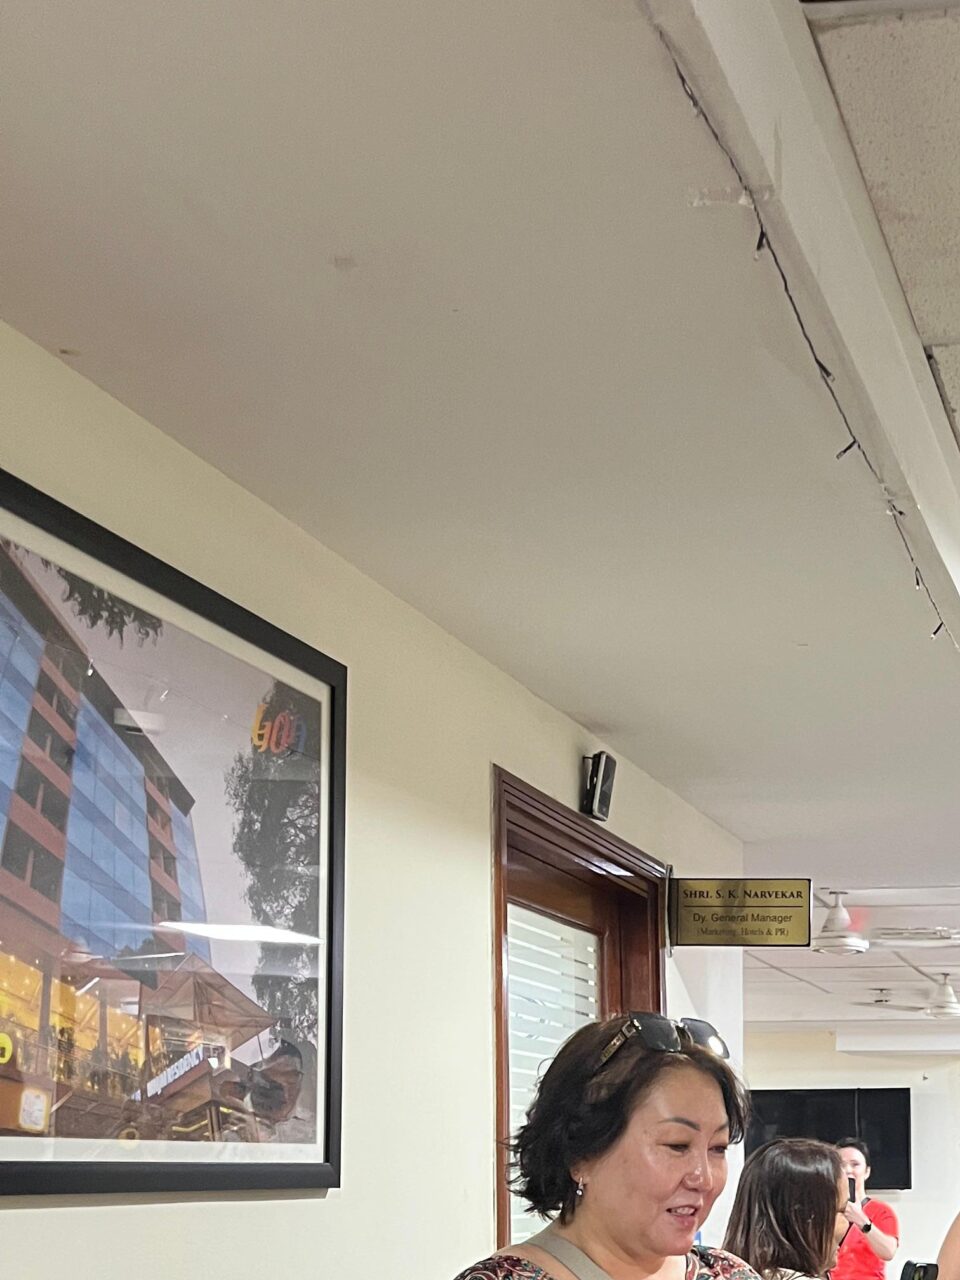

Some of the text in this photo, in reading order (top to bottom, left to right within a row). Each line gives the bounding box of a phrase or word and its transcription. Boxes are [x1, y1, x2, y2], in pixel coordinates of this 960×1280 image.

[683, 889, 712, 899] SHRI.
[743, 889, 803, 899] NARVEKAR
[711, 913, 749, 923] General
[751, 913, 793, 924] Manager
[765, 928, 772, 936] &
